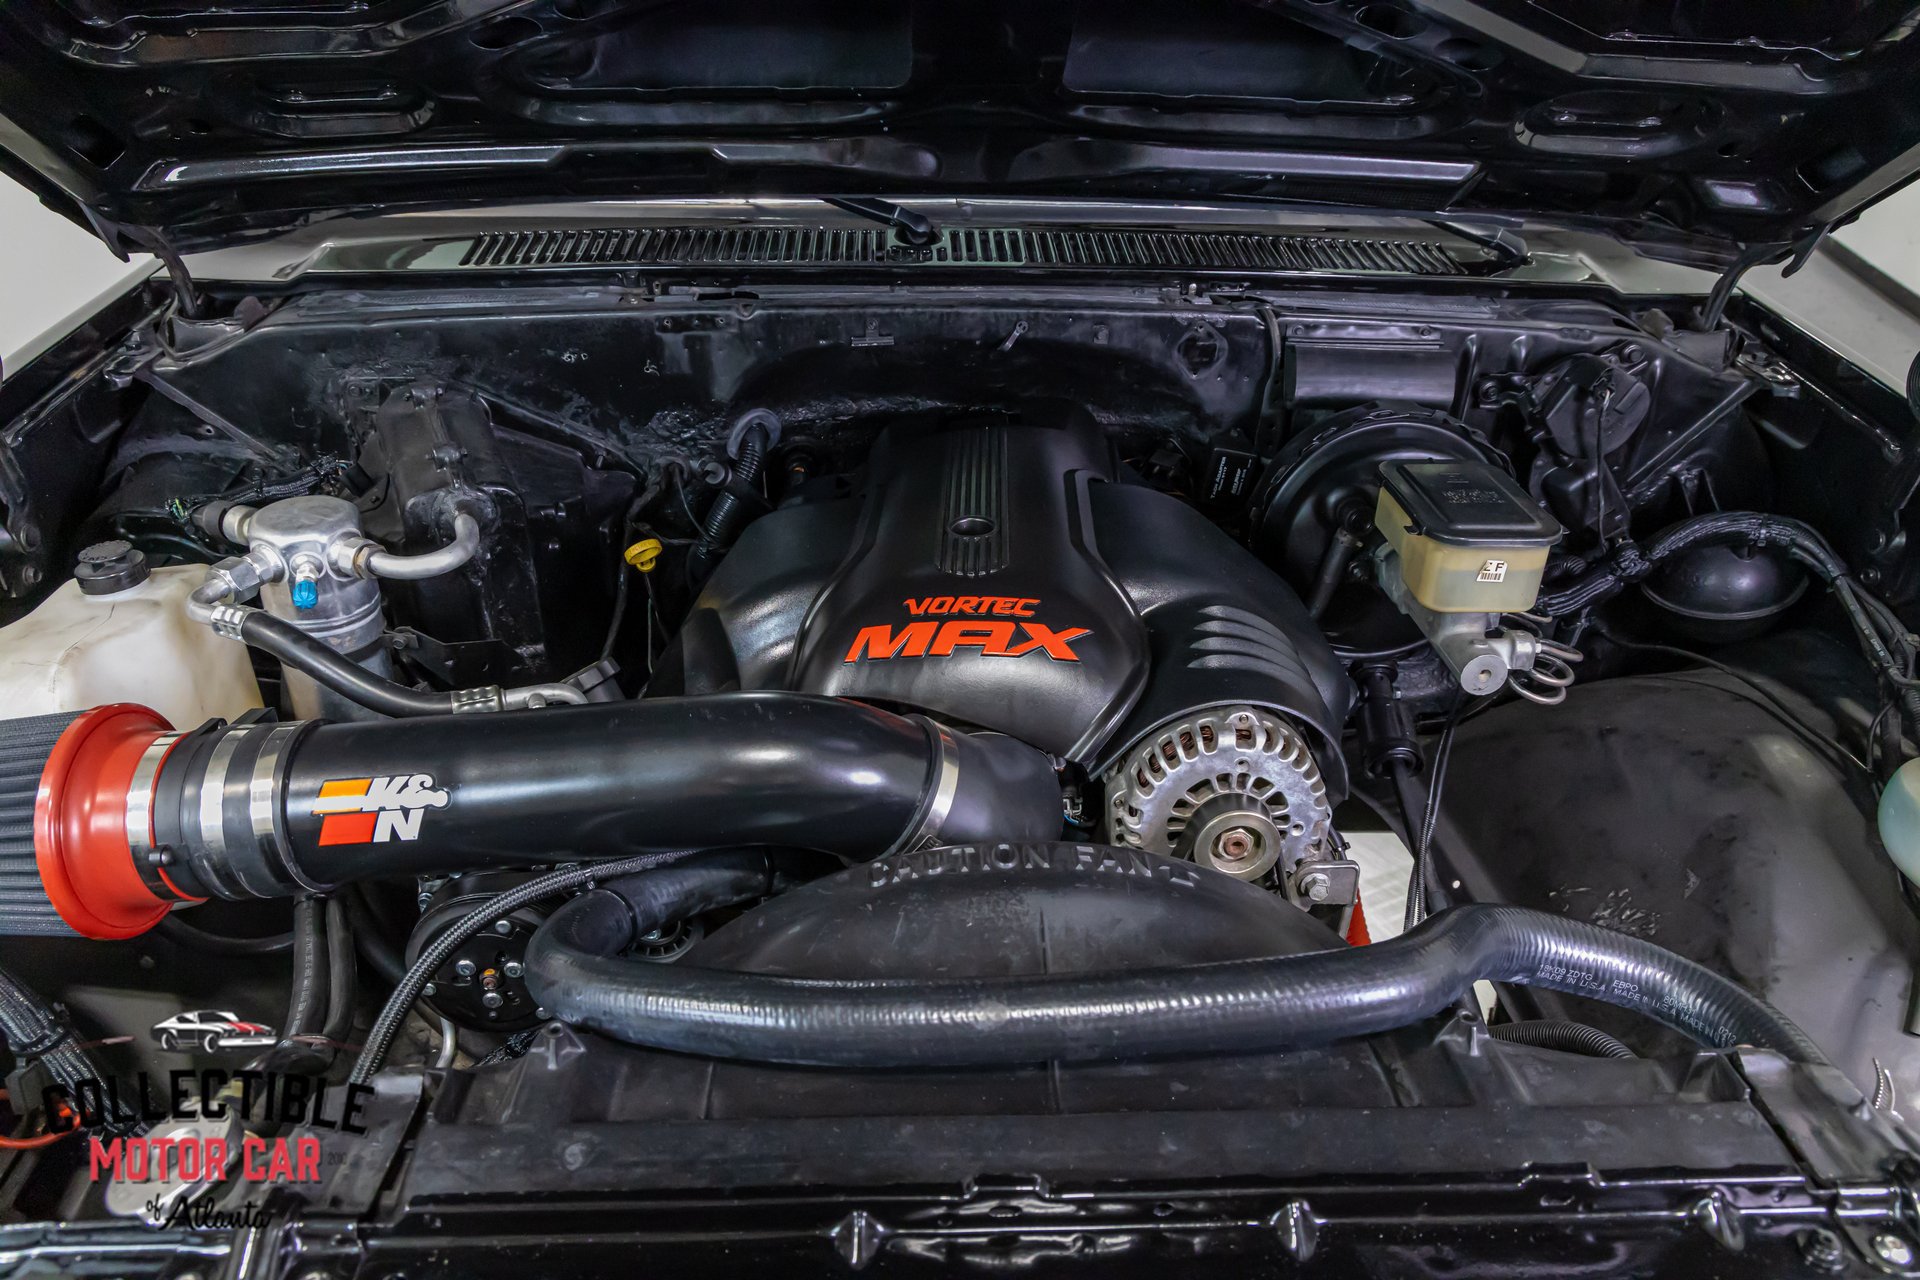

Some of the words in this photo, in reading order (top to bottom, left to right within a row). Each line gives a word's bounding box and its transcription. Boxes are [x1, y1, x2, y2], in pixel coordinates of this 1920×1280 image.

[903, 596, 1041, 617] VORTEC
[844, 620, 1094, 664] MAX
[869, 843, 1050, 888] CAUTION
[1535, 970, 1564, 982] MADE
[1566, 976, 1578, 985] IN
[1613, 988, 1642, 1000] MADE
